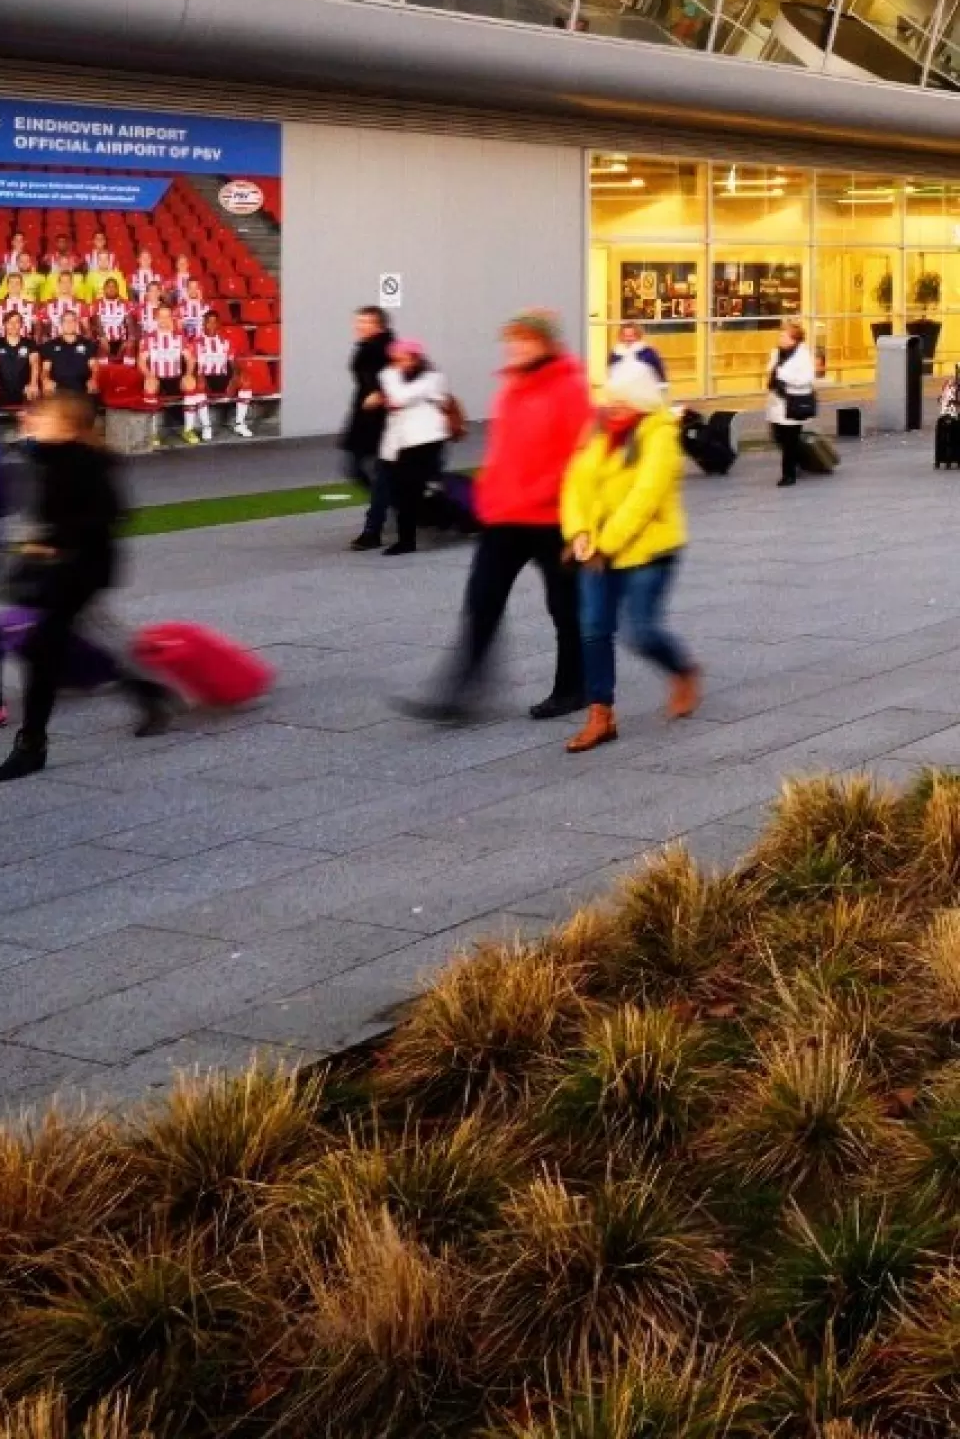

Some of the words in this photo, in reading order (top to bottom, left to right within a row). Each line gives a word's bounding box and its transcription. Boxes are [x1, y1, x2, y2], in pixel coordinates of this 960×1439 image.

[14, 117, 113, 136] EINDHOVEN
[117, 124, 187, 141] AIRPORT
[14, 136, 91, 153] OFFICIAL
[96, 141, 166, 158] AIRPORT
[168, 145, 189, 158] OF
[192, 146, 222, 160] PSV
